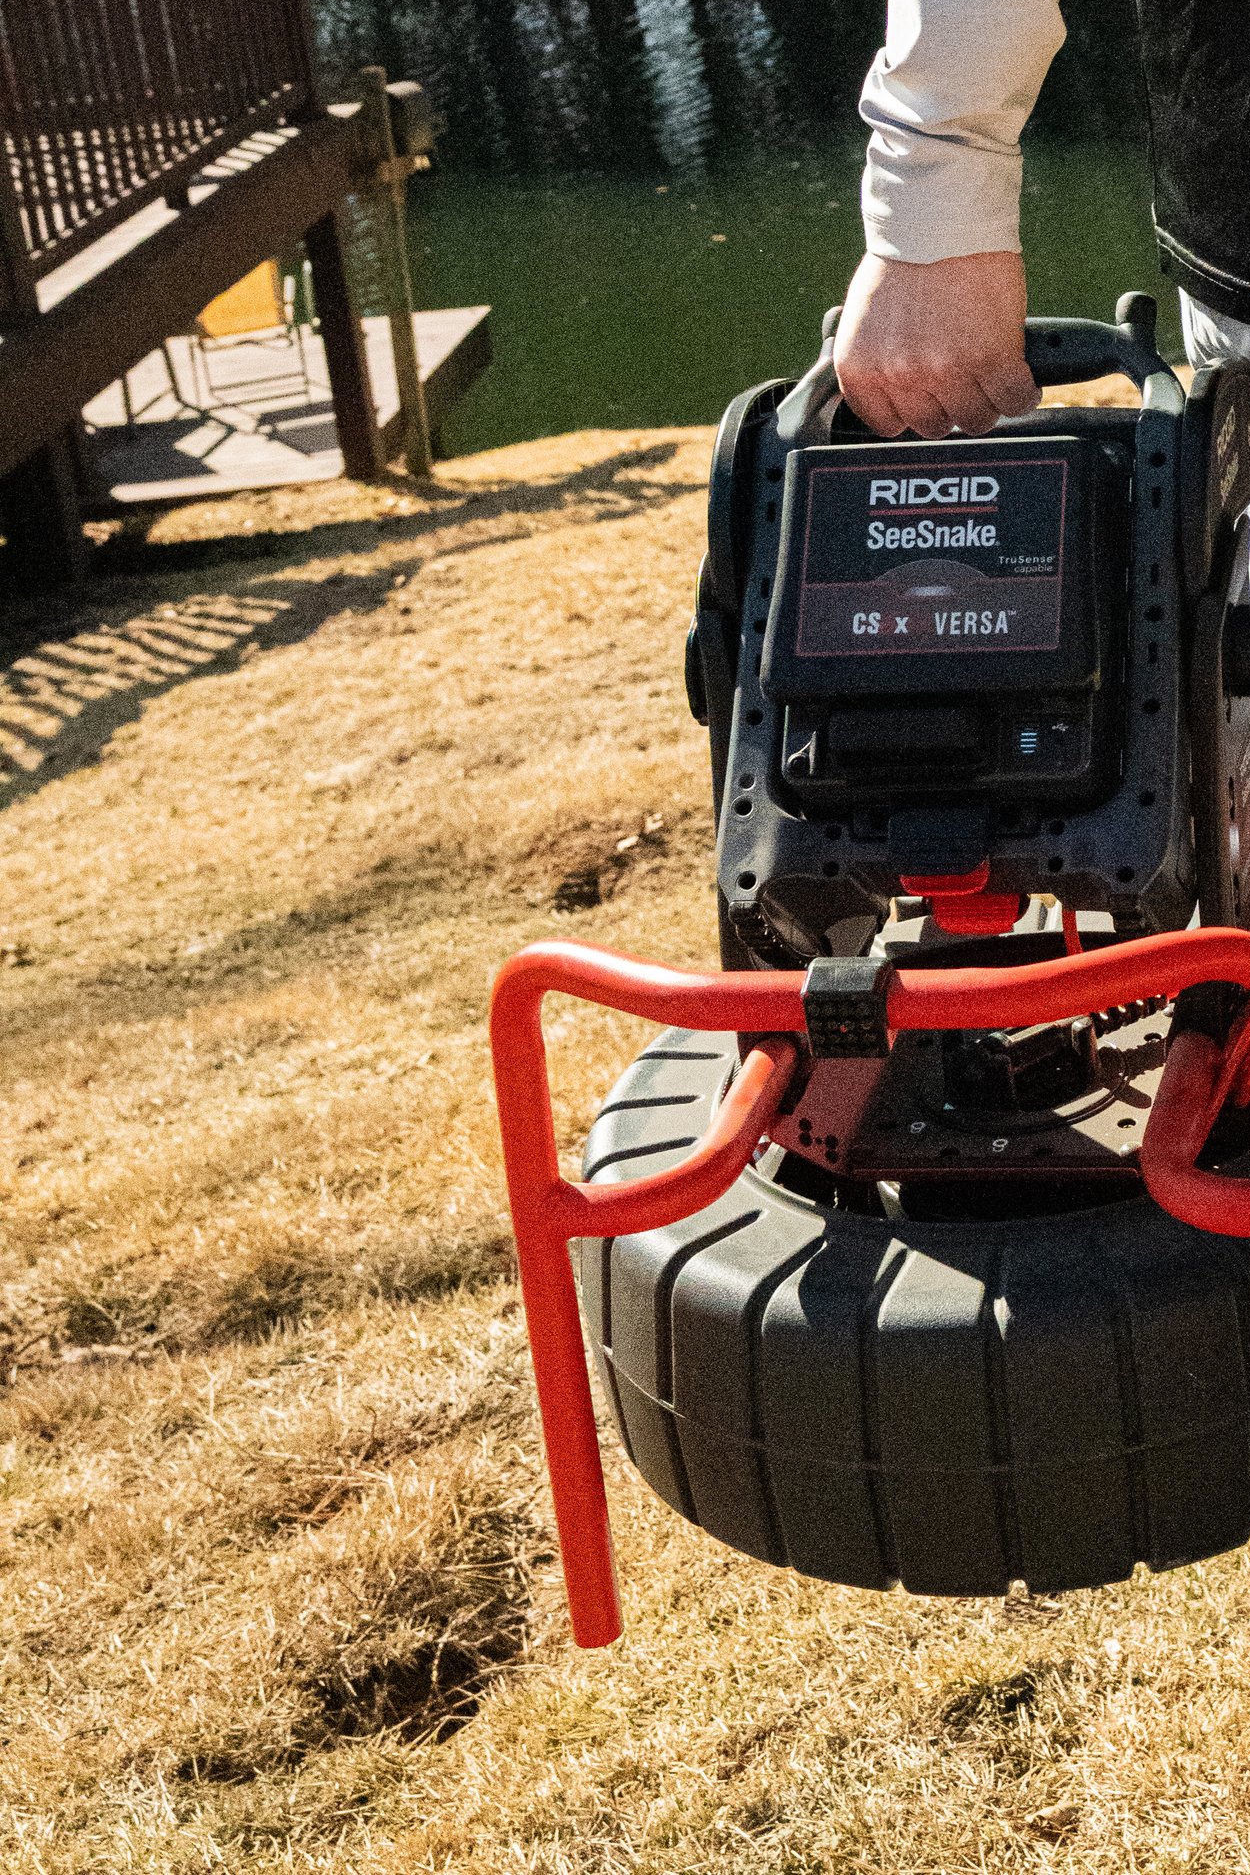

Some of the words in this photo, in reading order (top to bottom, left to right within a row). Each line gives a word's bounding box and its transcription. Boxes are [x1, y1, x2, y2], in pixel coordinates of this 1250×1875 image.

[869, 476, 1000, 505] RIDGID
[867, 519, 998, 550] SeeSnake
[998, 555, 1054, 565] TruSense
[1013, 564, 1053, 574] capable
[852, 612, 881, 635] CS
